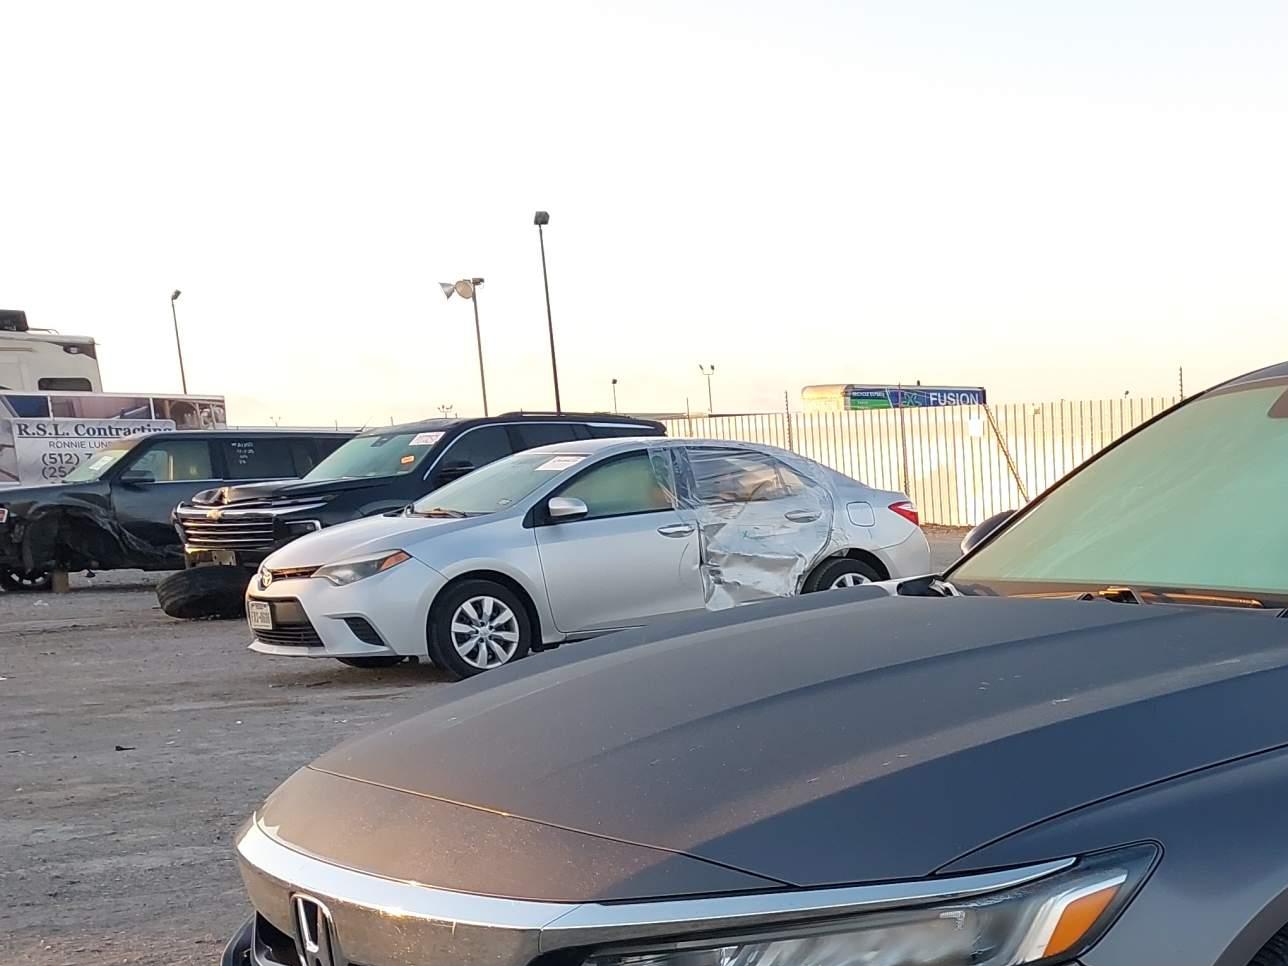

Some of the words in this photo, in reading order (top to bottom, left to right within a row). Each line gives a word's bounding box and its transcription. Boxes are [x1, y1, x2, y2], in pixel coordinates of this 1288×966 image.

[929, 392, 978, 405] FUSION
[17, 423, 69, 436] R.S.L.
[74, 423, 173, 436] Contracti
[42, 453, 79, 466] (512)
